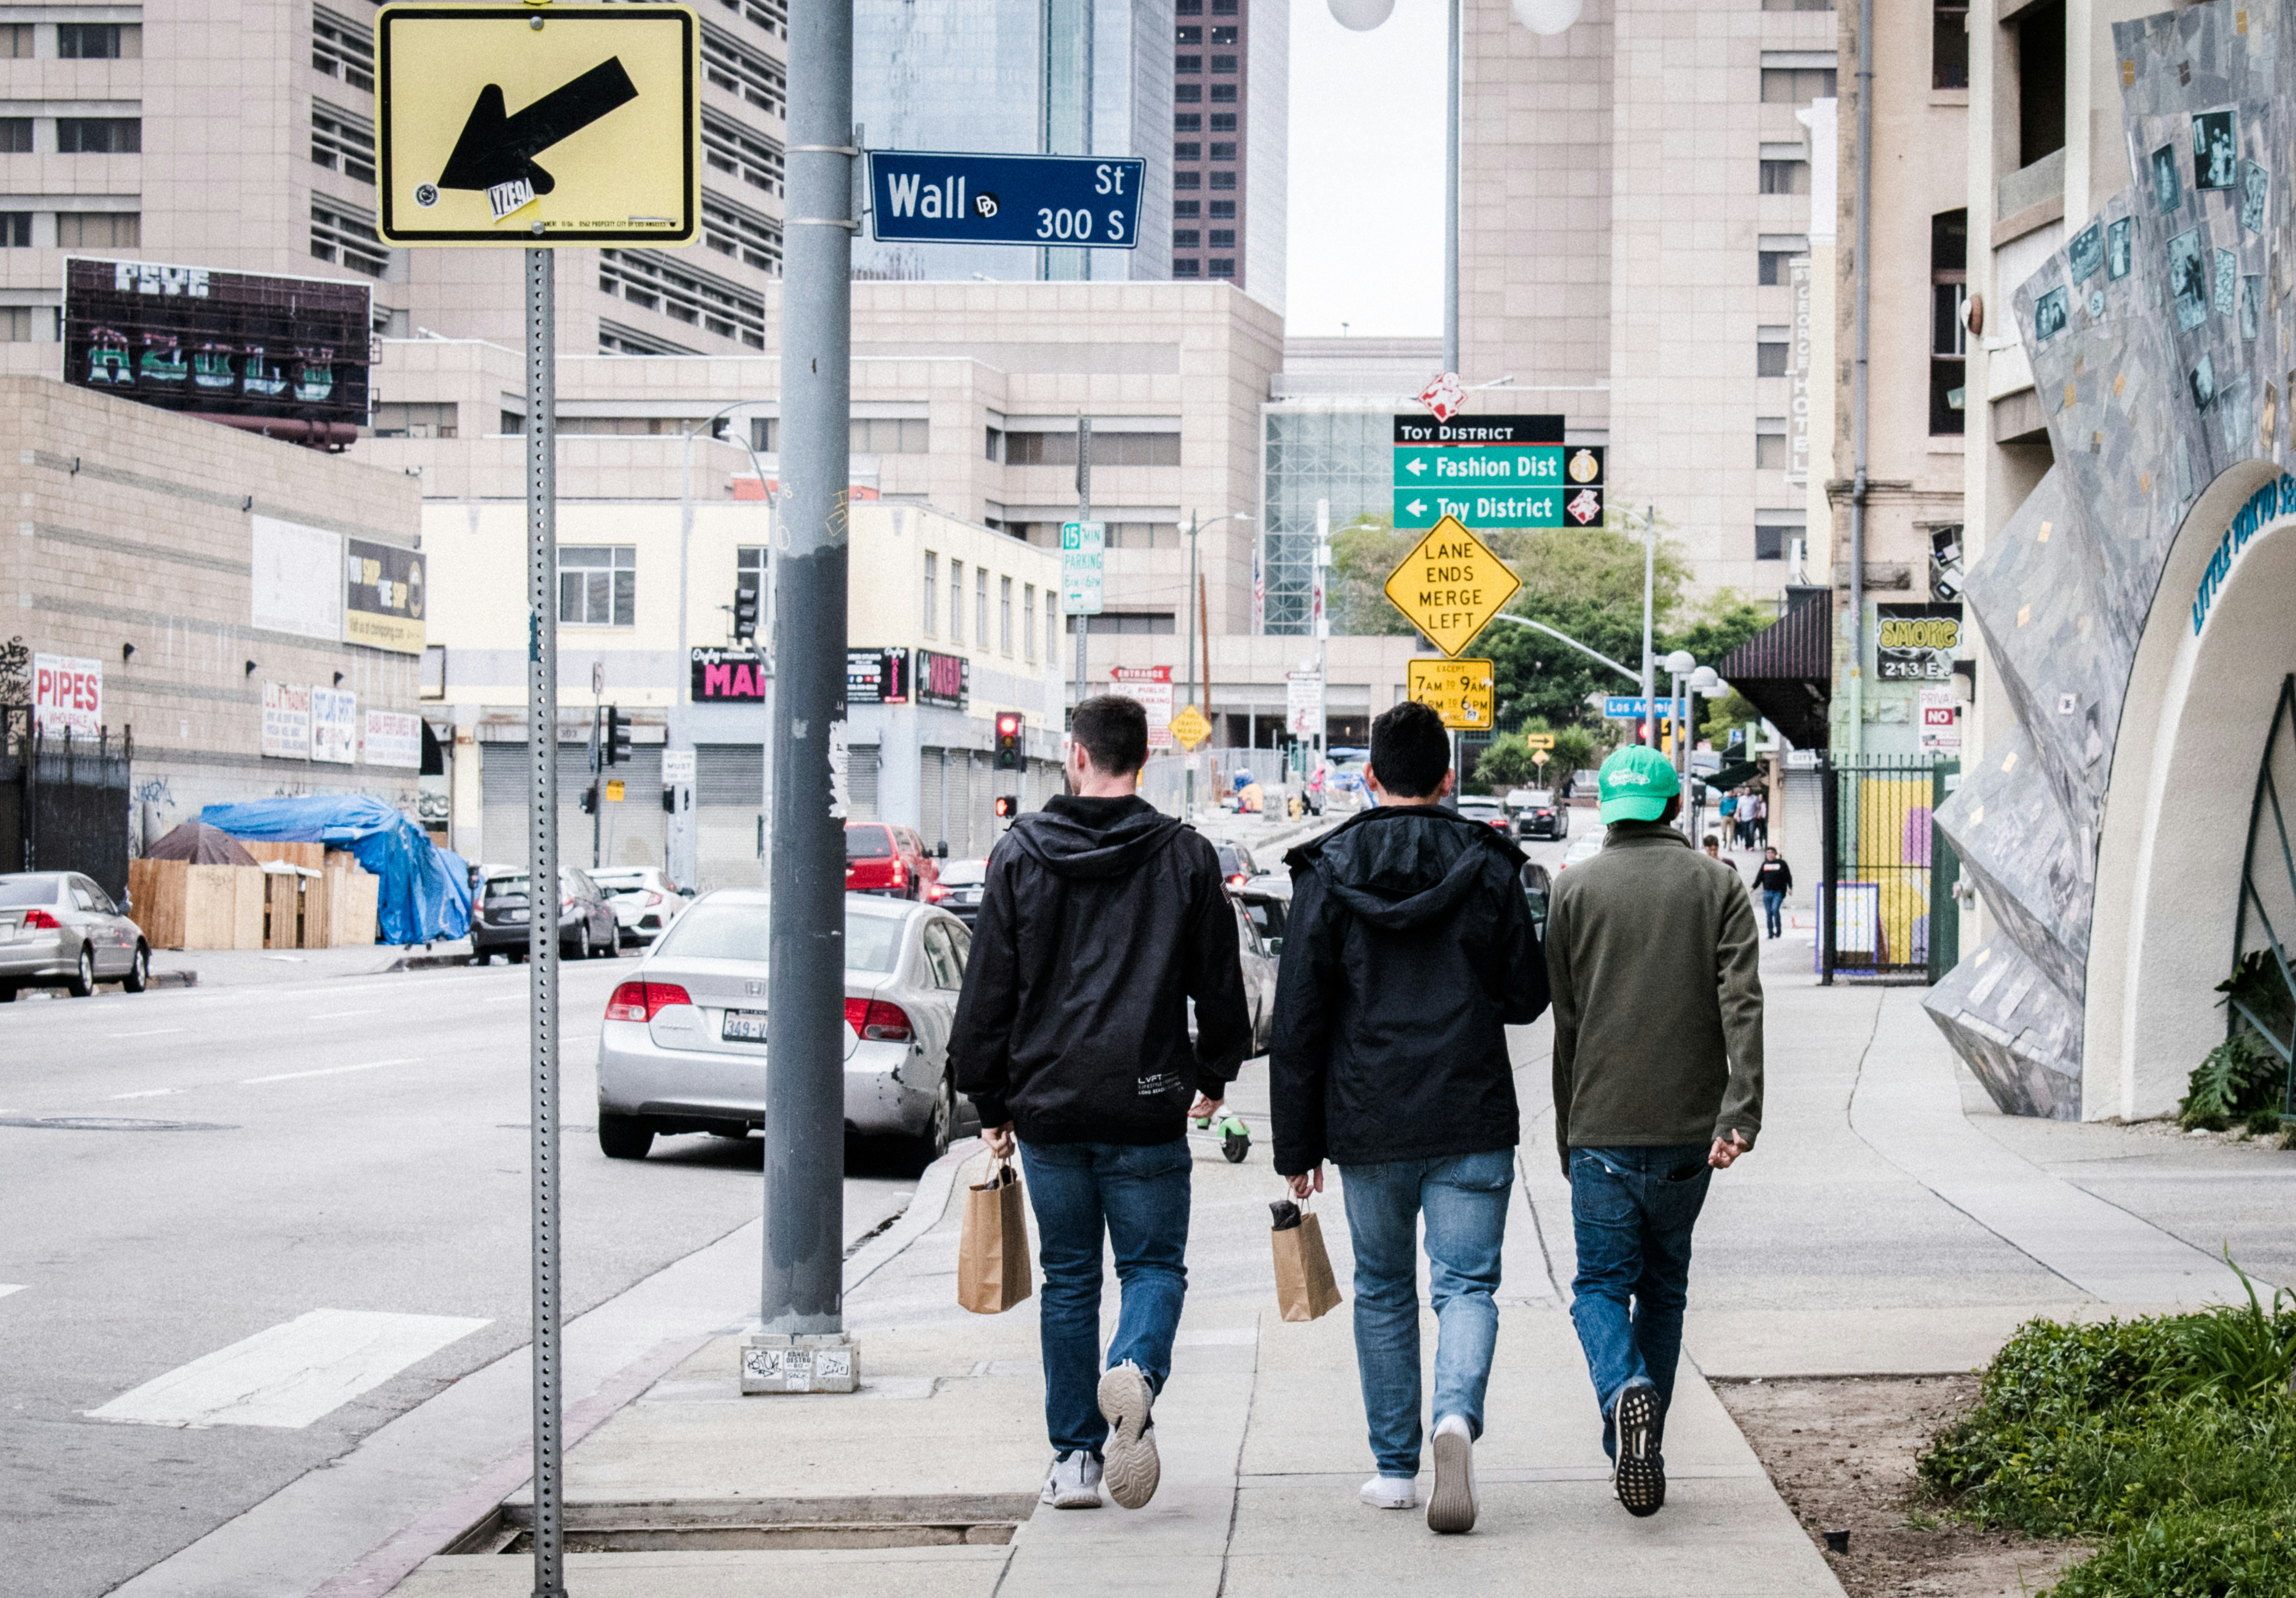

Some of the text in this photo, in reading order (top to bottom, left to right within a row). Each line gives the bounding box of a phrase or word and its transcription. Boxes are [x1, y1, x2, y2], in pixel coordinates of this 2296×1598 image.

[887, 164, 1124, 219] Wall St
[1036, 207, 1124, 240] 300 S
[1793, 377, 1810, 471] HOTEL
[1437, 456, 1557, 477] Fashion Dist
[1437, 497, 1553, 522] Toy District
[1065, 527, 1100, 547] 15 MIN
[1425, 542, 1474, 559] LANE
[2192, 530, 2231, 637] LITTLE
[2231, 478, 2277, 554] TOKYO
[1065, 553, 1102, 570] PARKING
[1427, 566, 1474, 583] ENDS
[1419, 589, 1482, 606] MERGE
[1429, 613, 1474, 629] LEFT
[1117, 669, 1164, 679] ENTRANCE
[1885, 662, 1938, 676] 213 E
[37, 669, 98, 711] PIPES
[1609, 700, 1629, 713] Los
[1928, 710, 1949, 723] NO
[1138, 1074, 1162, 1084] LVFT
